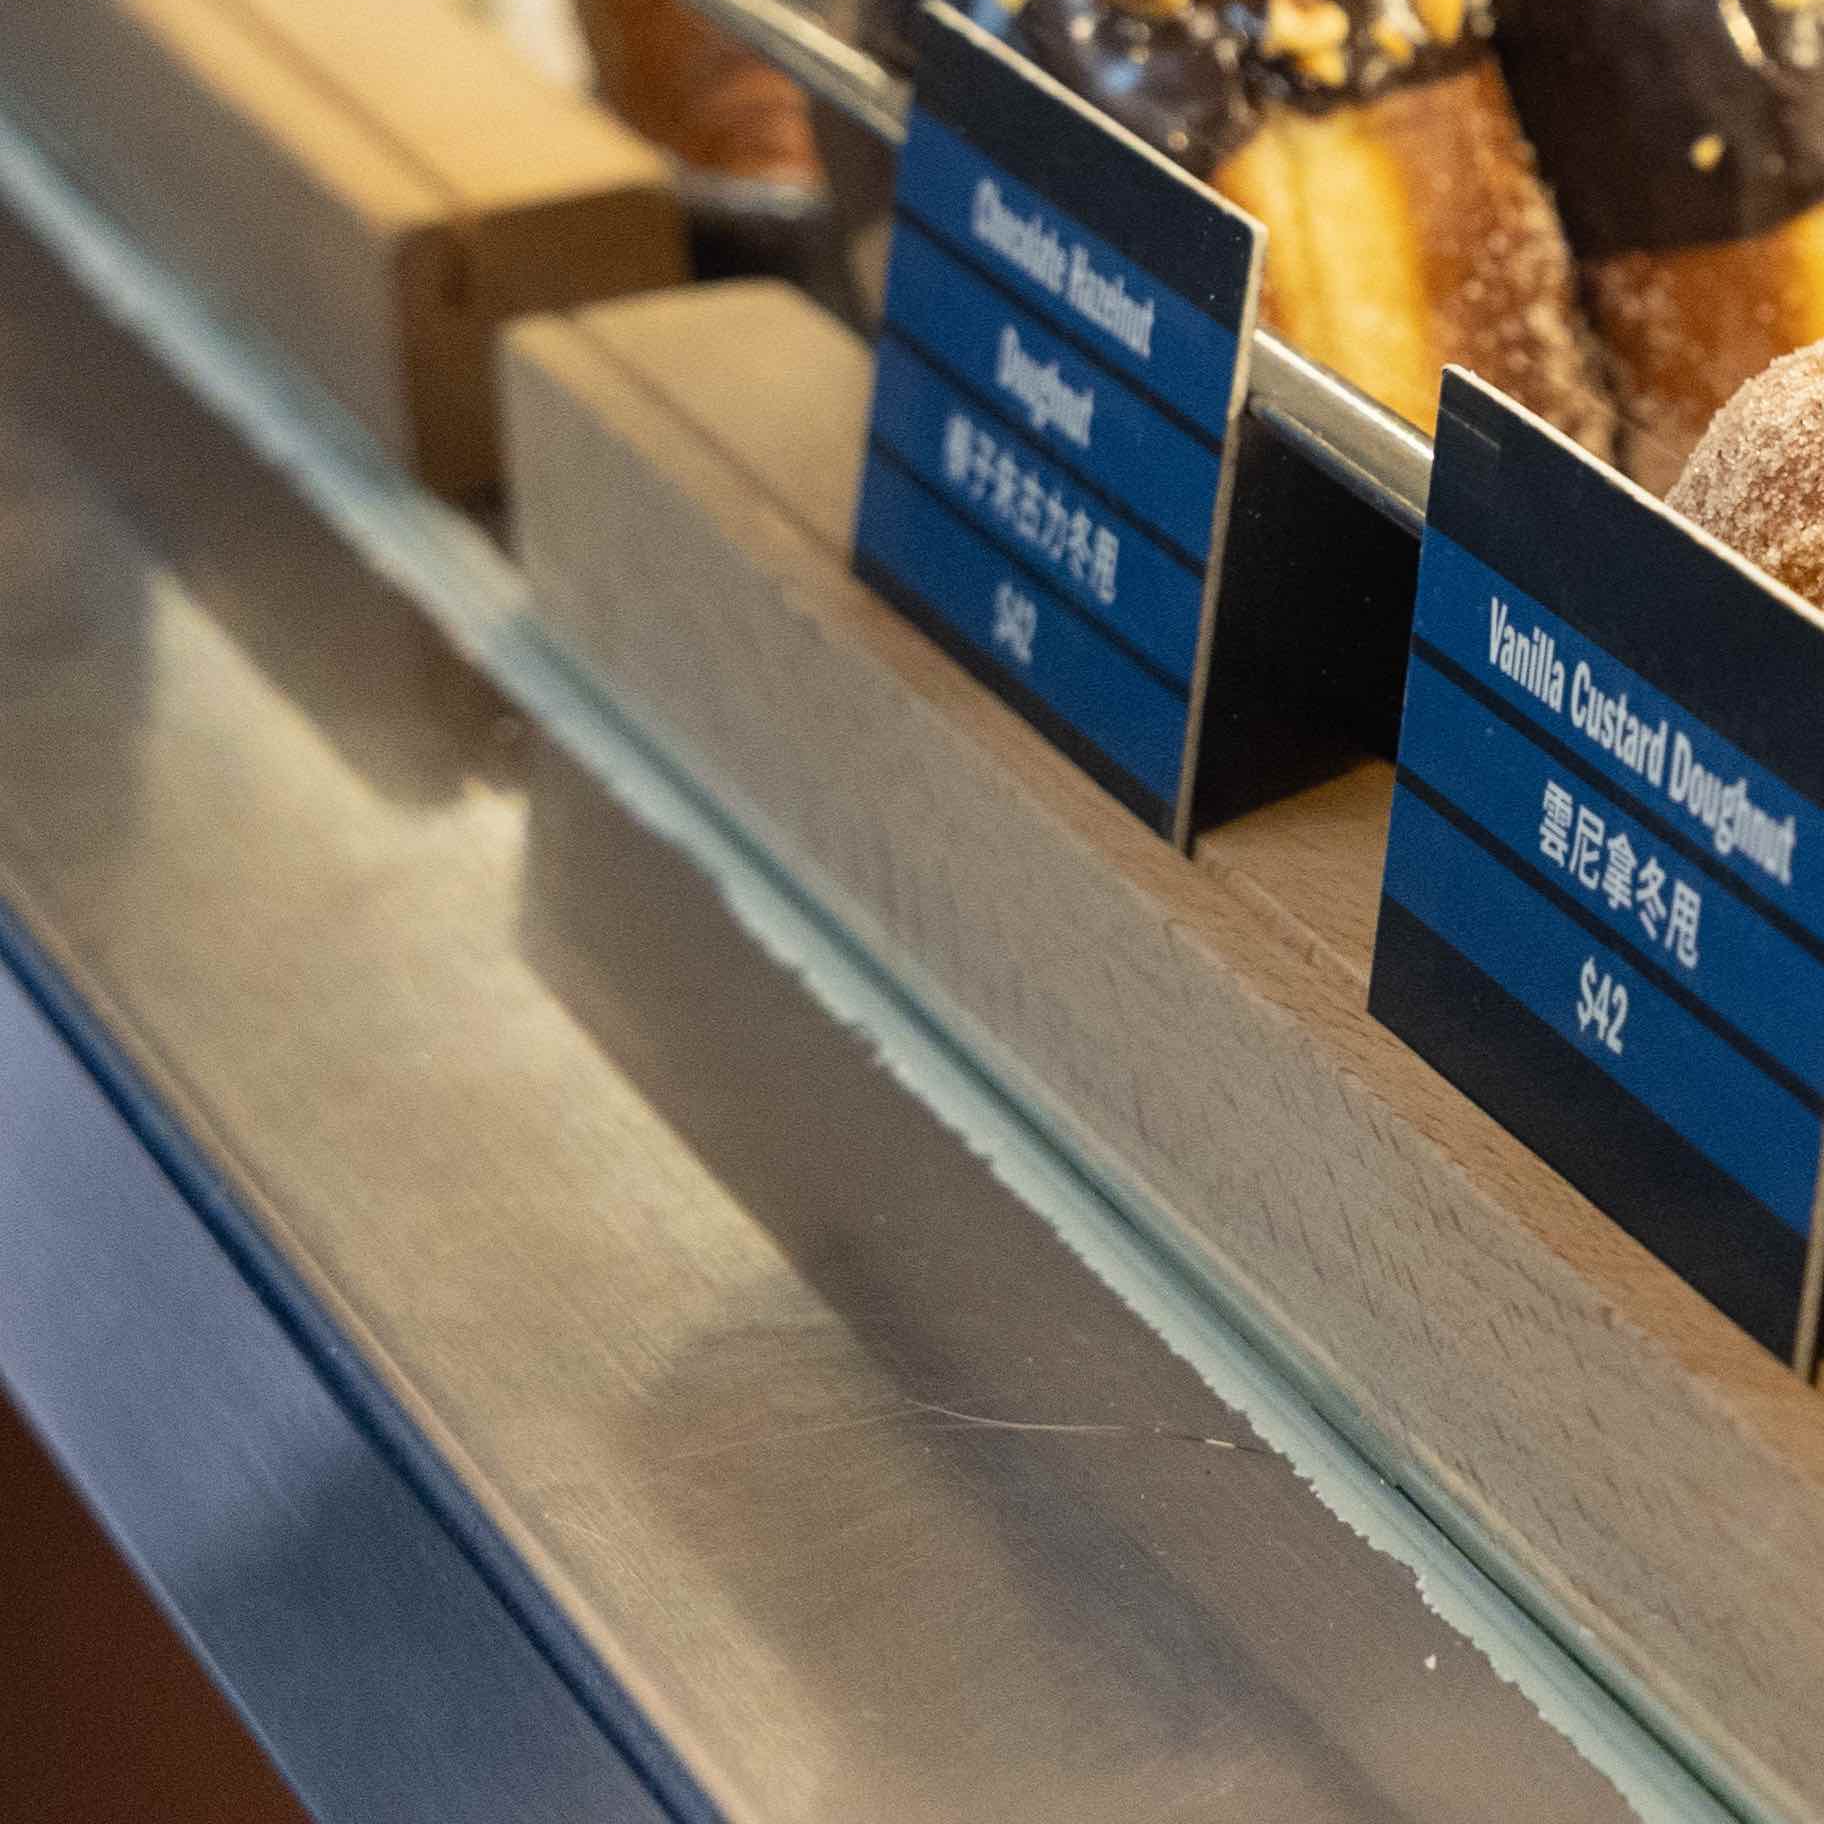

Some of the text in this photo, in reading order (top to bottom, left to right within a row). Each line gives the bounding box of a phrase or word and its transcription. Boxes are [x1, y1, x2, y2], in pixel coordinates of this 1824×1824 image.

[973, 178, 1155, 358] Chocolate Hazelnut
[997, 324, 1094, 448] Doughnut
[1488, 596, 1797, 886] Vanilla Custard Doughnut
[1539, 779, 1701, 970] 雲尼拿冬甩
[1576, 956, 1630, 1055] $42
